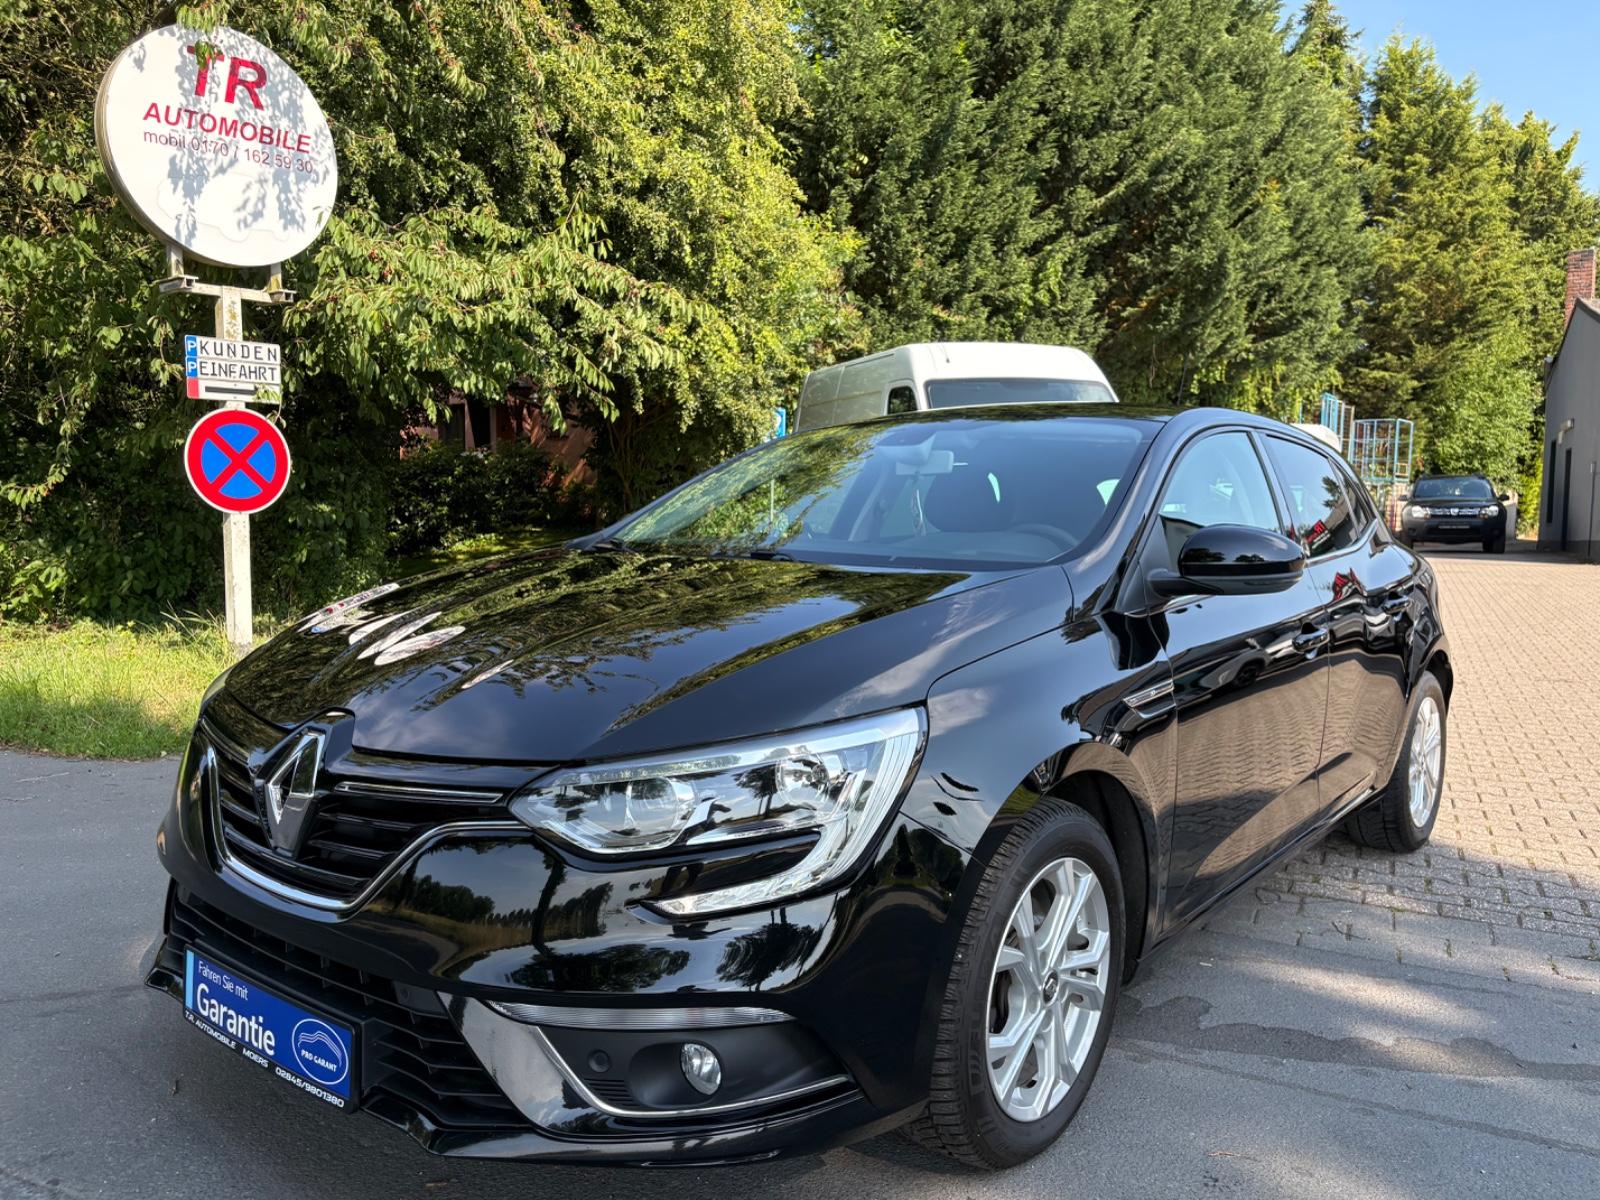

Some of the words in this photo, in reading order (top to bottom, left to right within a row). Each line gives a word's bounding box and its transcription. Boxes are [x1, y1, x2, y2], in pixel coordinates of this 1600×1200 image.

[187, 45, 268, 111] TR
[143, 102, 312, 154] AUTOMOBILE
[143, 131, 186, 149] mobil
[191, 137, 229, 156] 0170
[244, 148, 270, 165] 162
[275, 154, 292, 169] 59
[296, 158, 313, 173] 30
[199, 361, 277, 381] EINFAHRT
[200, 340, 277, 362] KUNDEN
[198, 960, 222, 985] Fahren
[222, 975, 234, 993] Sie
[235, 985, 249, 1001] mit
[196, 983, 276, 1056] Garantie
[195, 1019, 237, 1050] AUTOMOBILE
[242, 1047, 269, 1068] MOERS
[301, 1049, 314, 1061] PRO
